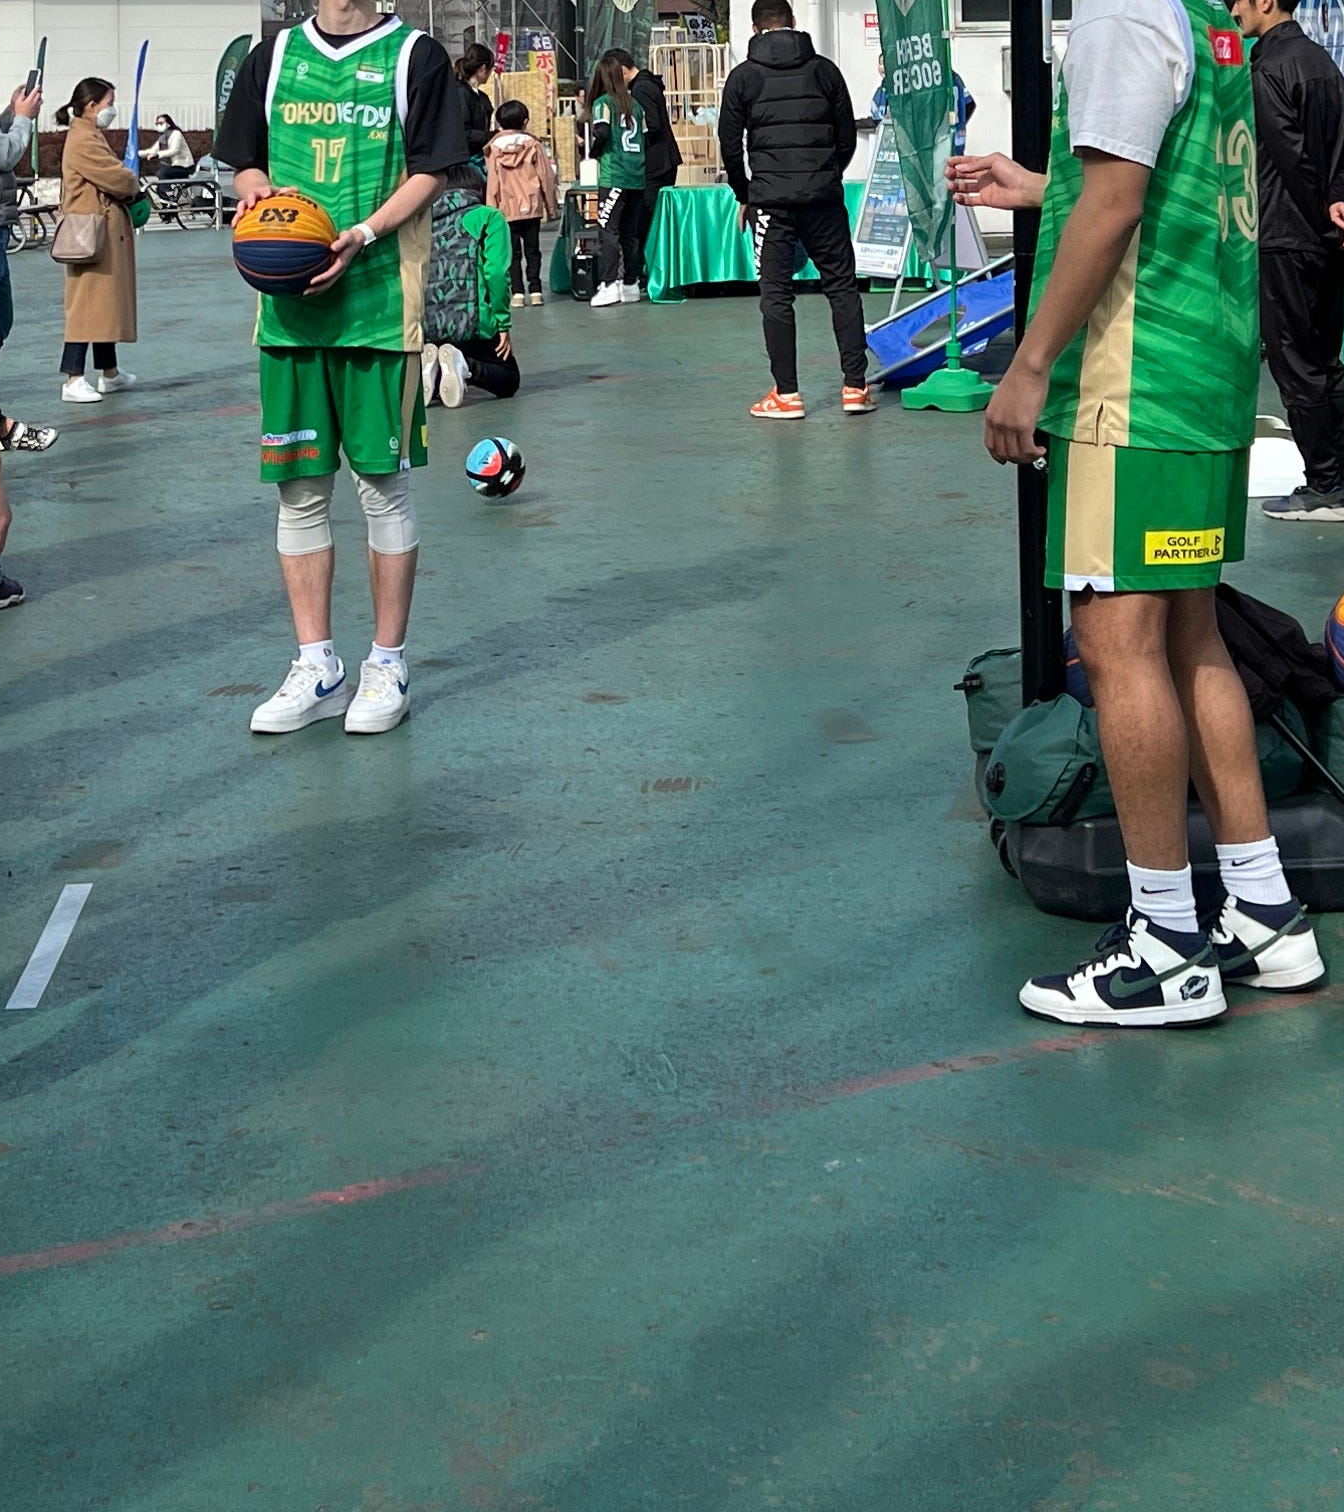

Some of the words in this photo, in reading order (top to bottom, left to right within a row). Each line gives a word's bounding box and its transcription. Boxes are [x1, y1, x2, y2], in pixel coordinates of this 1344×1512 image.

[620, 113, 641, 154] 2
[311, 137, 346, 183] 17
[1153, 548, 1210, 559] PARTNER
[1167, 535, 1201, 547] GOLF
